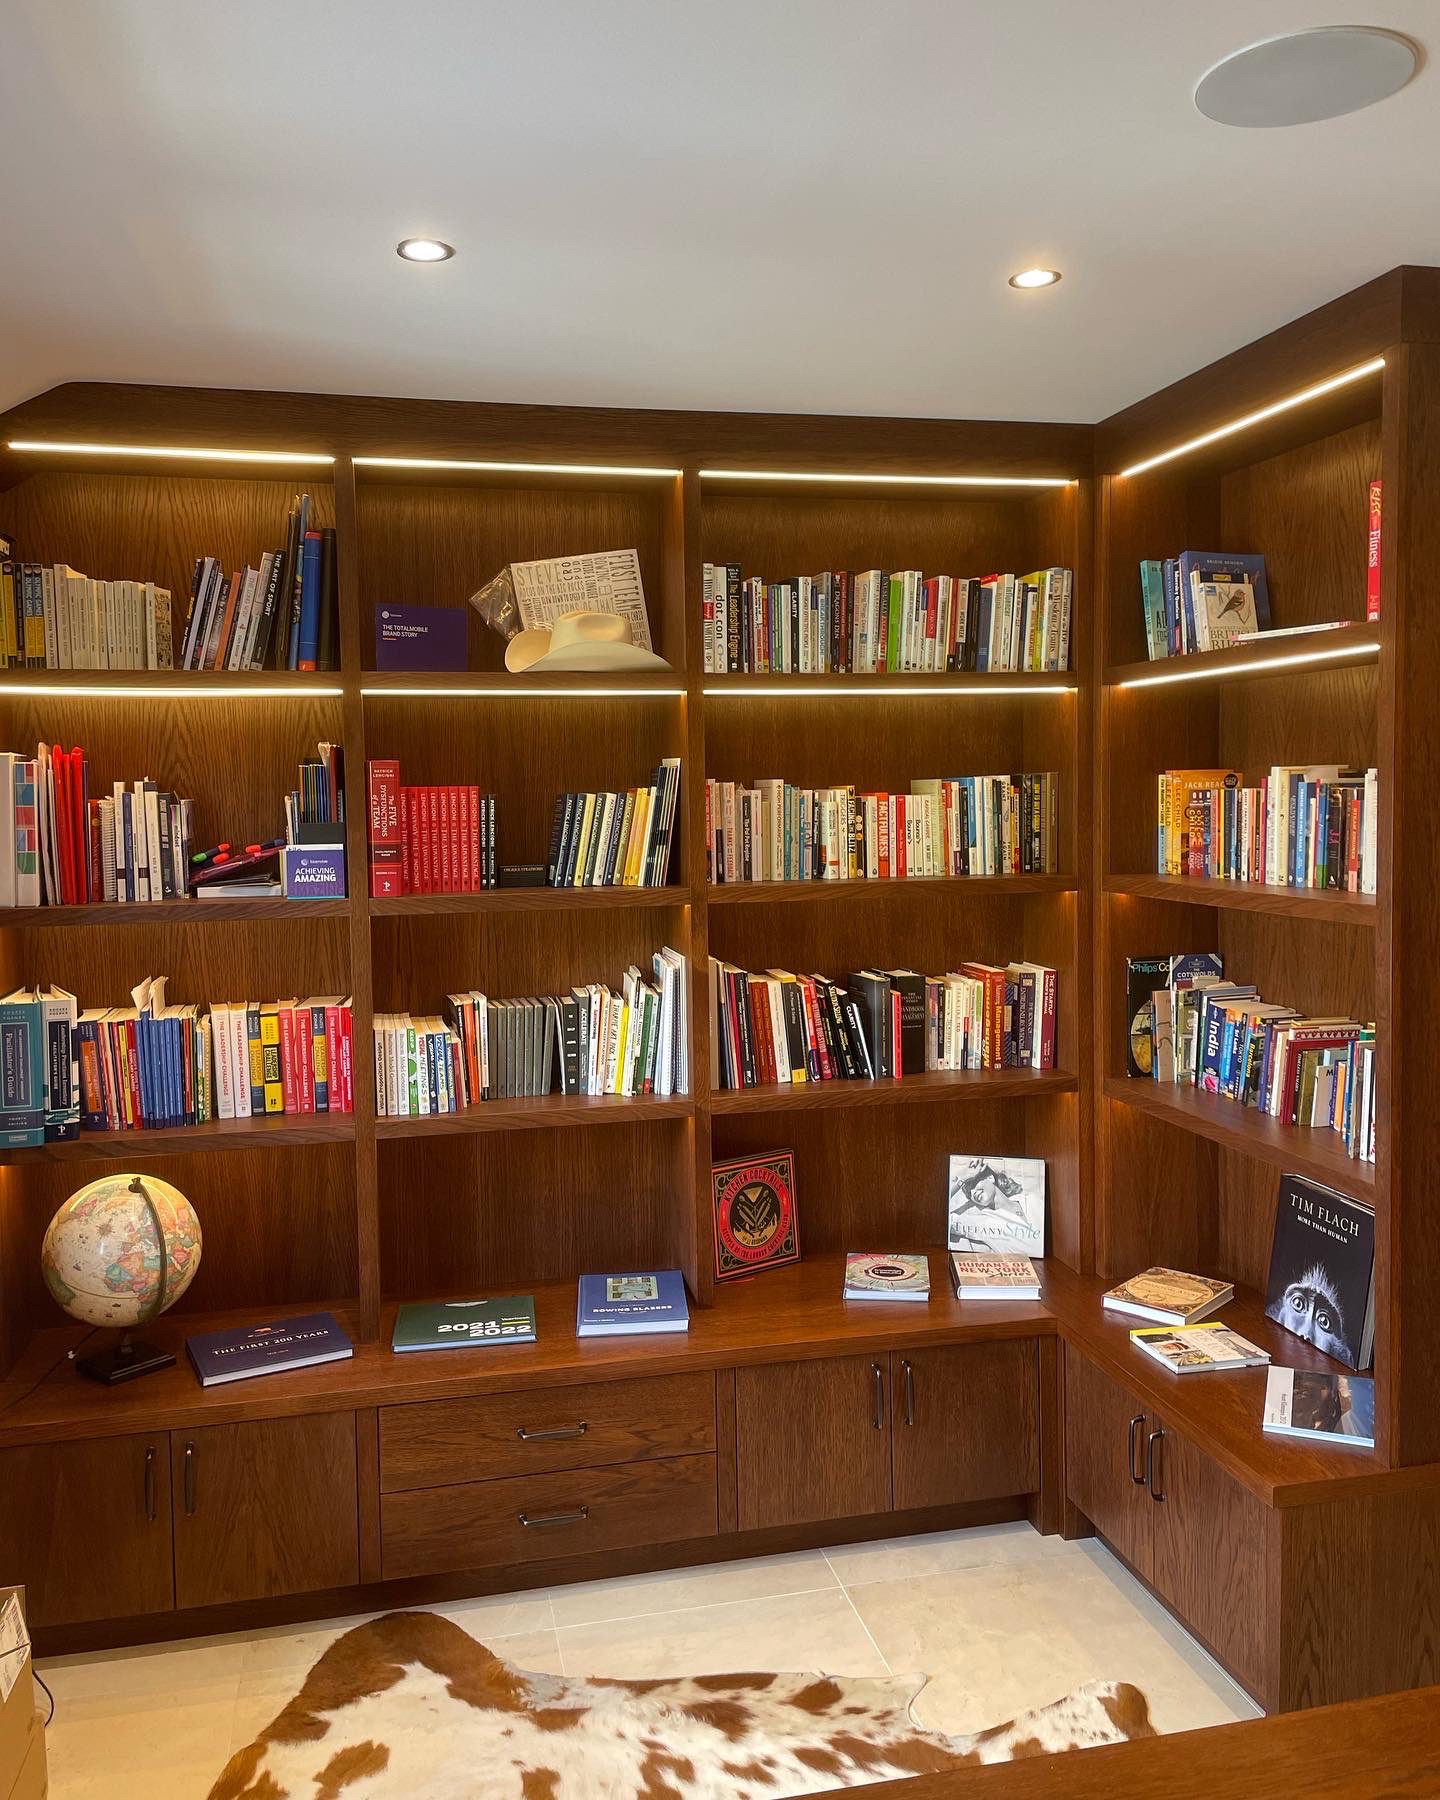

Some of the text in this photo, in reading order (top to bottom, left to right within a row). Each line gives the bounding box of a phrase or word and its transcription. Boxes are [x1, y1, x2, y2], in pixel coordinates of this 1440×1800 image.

[516, 562, 562, 587] STEVE
[607, 554, 637, 582] FIRST
[270, 583, 276, 592] OF
[613, 586, 642, 612] TEAM
[265, 593, 274, 616] SPORT
[716, 595, 725, 639] dot.con
[729, 595, 739, 633] Leadership
[1184, 782, 1203, 790] JACK
[388, 806, 397, 827] FIVE
[879, 801, 888, 856] FACTFULNESS
[294, 874, 336, 883] AMAZING
[846, 1006, 856, 1029] CLARITY
[1207, 1021, 1220, 1056] India
[1246, 1043, 1255, 1078] Barcelona
[724, 1168, 784, 1202] KITCHEN COCKTAILS
[1290, 1193, 1360, 1238] TIM FLACH
[953, 1221, 1042, 1240] TIFFANY Style
[1297, 1215, 1349, 1245] MORE THAN HUMAN
[958, 1261, 1027, 1269] HUMANS OF
[960, 1266, 1031, 1274] NEW YORK
[437, 1321, 500, 1334] 2021
[469, 1325, 532, 1338] 2022
[213, 1346, 236, 1356] THE
[239, 1340, 270, 1351] FIRST
[274, 1336, 293, 1345] 200
[295, 1329, 330, 1340] YEARS
